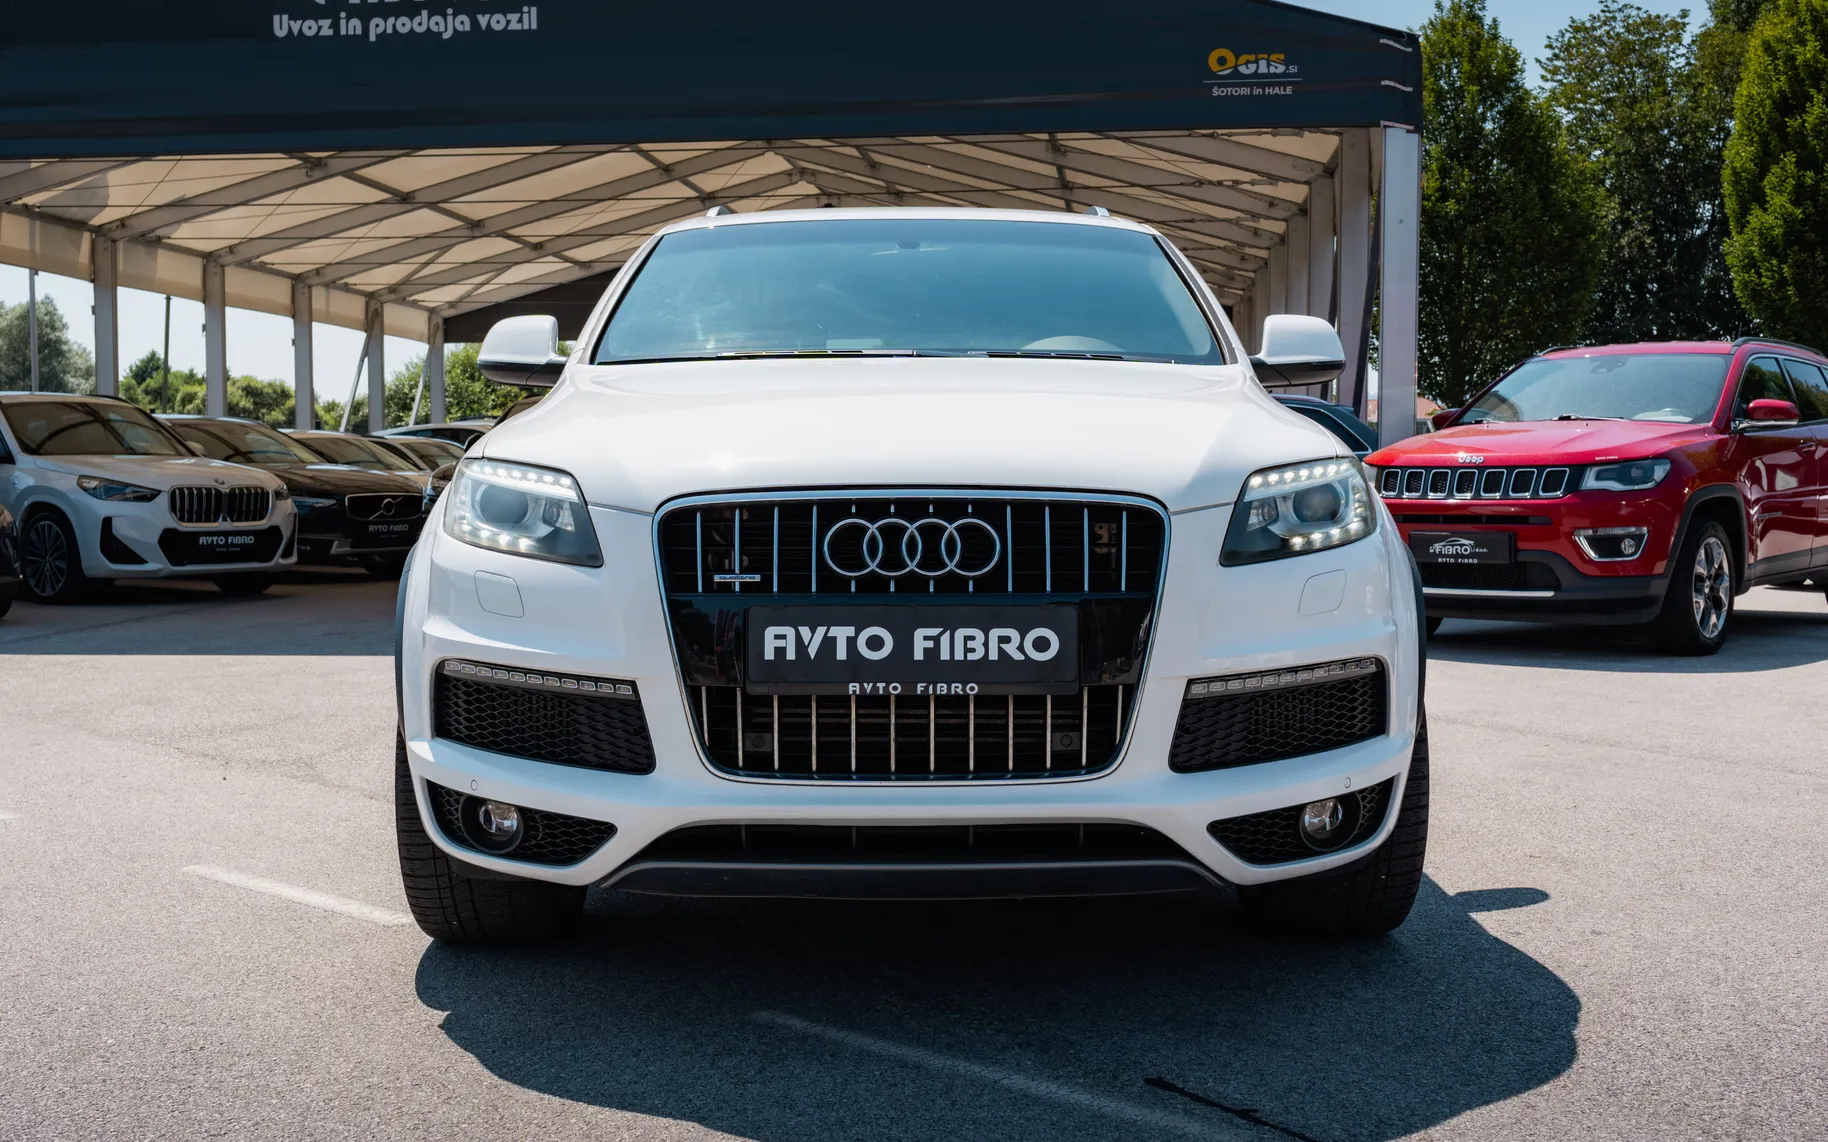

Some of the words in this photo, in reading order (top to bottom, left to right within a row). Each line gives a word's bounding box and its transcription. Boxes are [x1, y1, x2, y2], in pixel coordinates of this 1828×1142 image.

[273, 14, 333, 38] Uvoz
[339, 11, 362, 35] in
[369, 8, 471, 42] prodaja
[476, 6, 537, 31] vozil
[1212, 86, 1250, 96] ŠOTORI
[1253, 86, 1262, 95] in
[1265, 86, 1293, 95] HALE
[1458, 455, 1484, 465] Jeep
[199, 536, 226, 545] AVTO
[1435, 545, 1471, 555] FIBRO
[764, 626, 894, 660] AVTO
[913, 627, 1060, 662] FIBRO
[848, 682, 902, 695] AVTO
[916, 682, 979, 695] FIBRO
